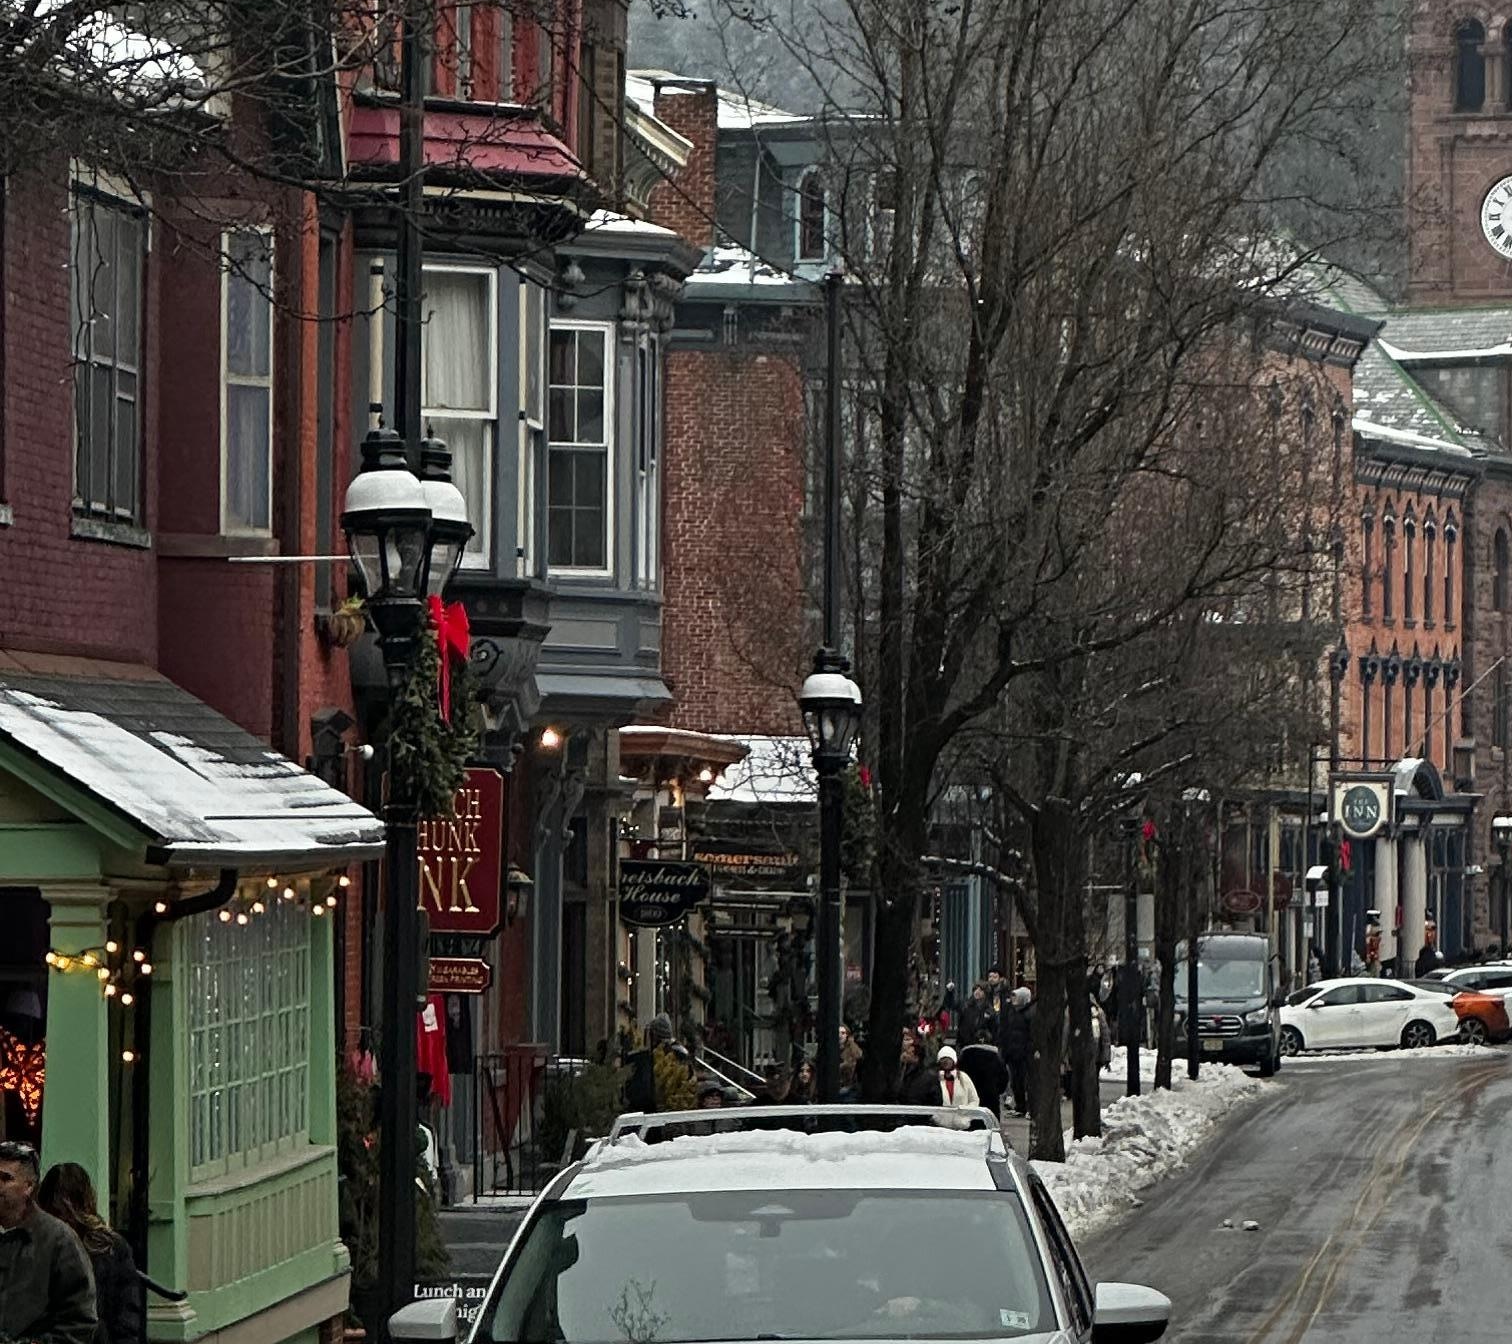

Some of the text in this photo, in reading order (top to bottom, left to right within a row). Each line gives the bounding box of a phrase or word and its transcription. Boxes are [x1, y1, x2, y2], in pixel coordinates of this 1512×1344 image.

[1345, 804, 1378, 819] INN
[417, 820, 481, 853] HUNK
[416, 855, 481, 913] NK
[622, 867, 700, 886] reisbach
[622, 884, 681, 904] House
[413, 1283, 487, 1299] Lunch an
